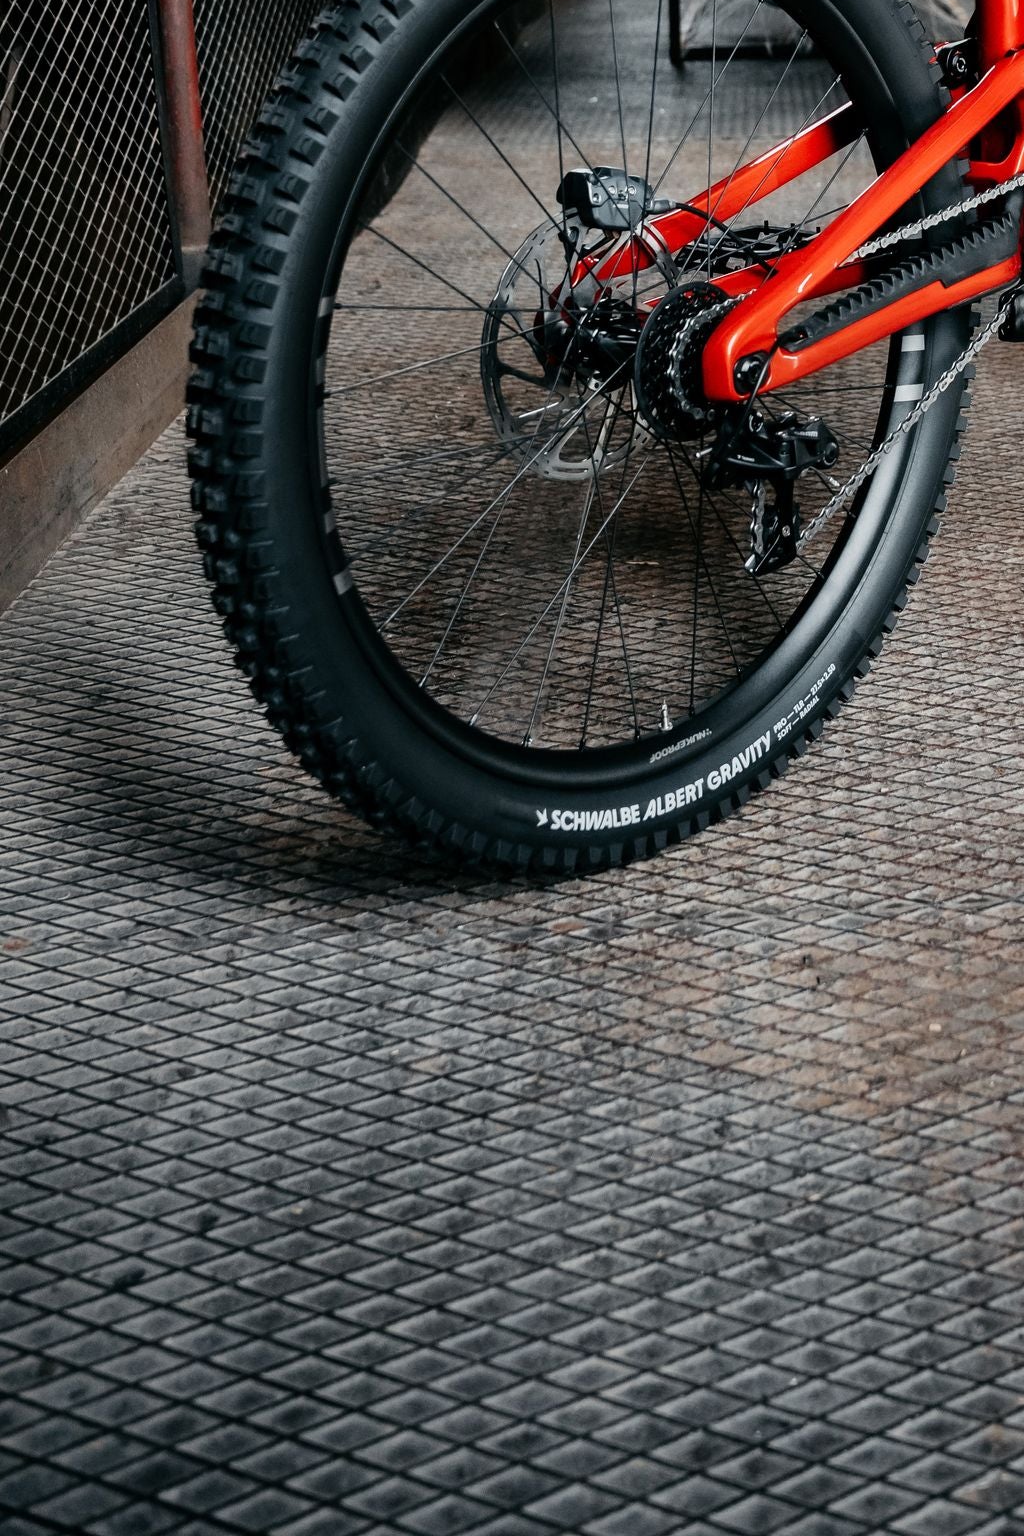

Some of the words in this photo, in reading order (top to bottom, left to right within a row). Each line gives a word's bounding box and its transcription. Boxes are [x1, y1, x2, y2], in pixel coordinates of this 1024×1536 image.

[773, 718, 789, 734] PRO
[793, 700, 806, 714] TLR
[777, 722, 793, 741] SOFT
[799, 695, 820, 720] RADIAL
[650, 729, 706, 764] NUKEPROOF
[550, 803, 641, 831] SCHWALBE
[642, 778, 704, 822] ALBERT
[706, 730, 771, 791] GRAVITY
